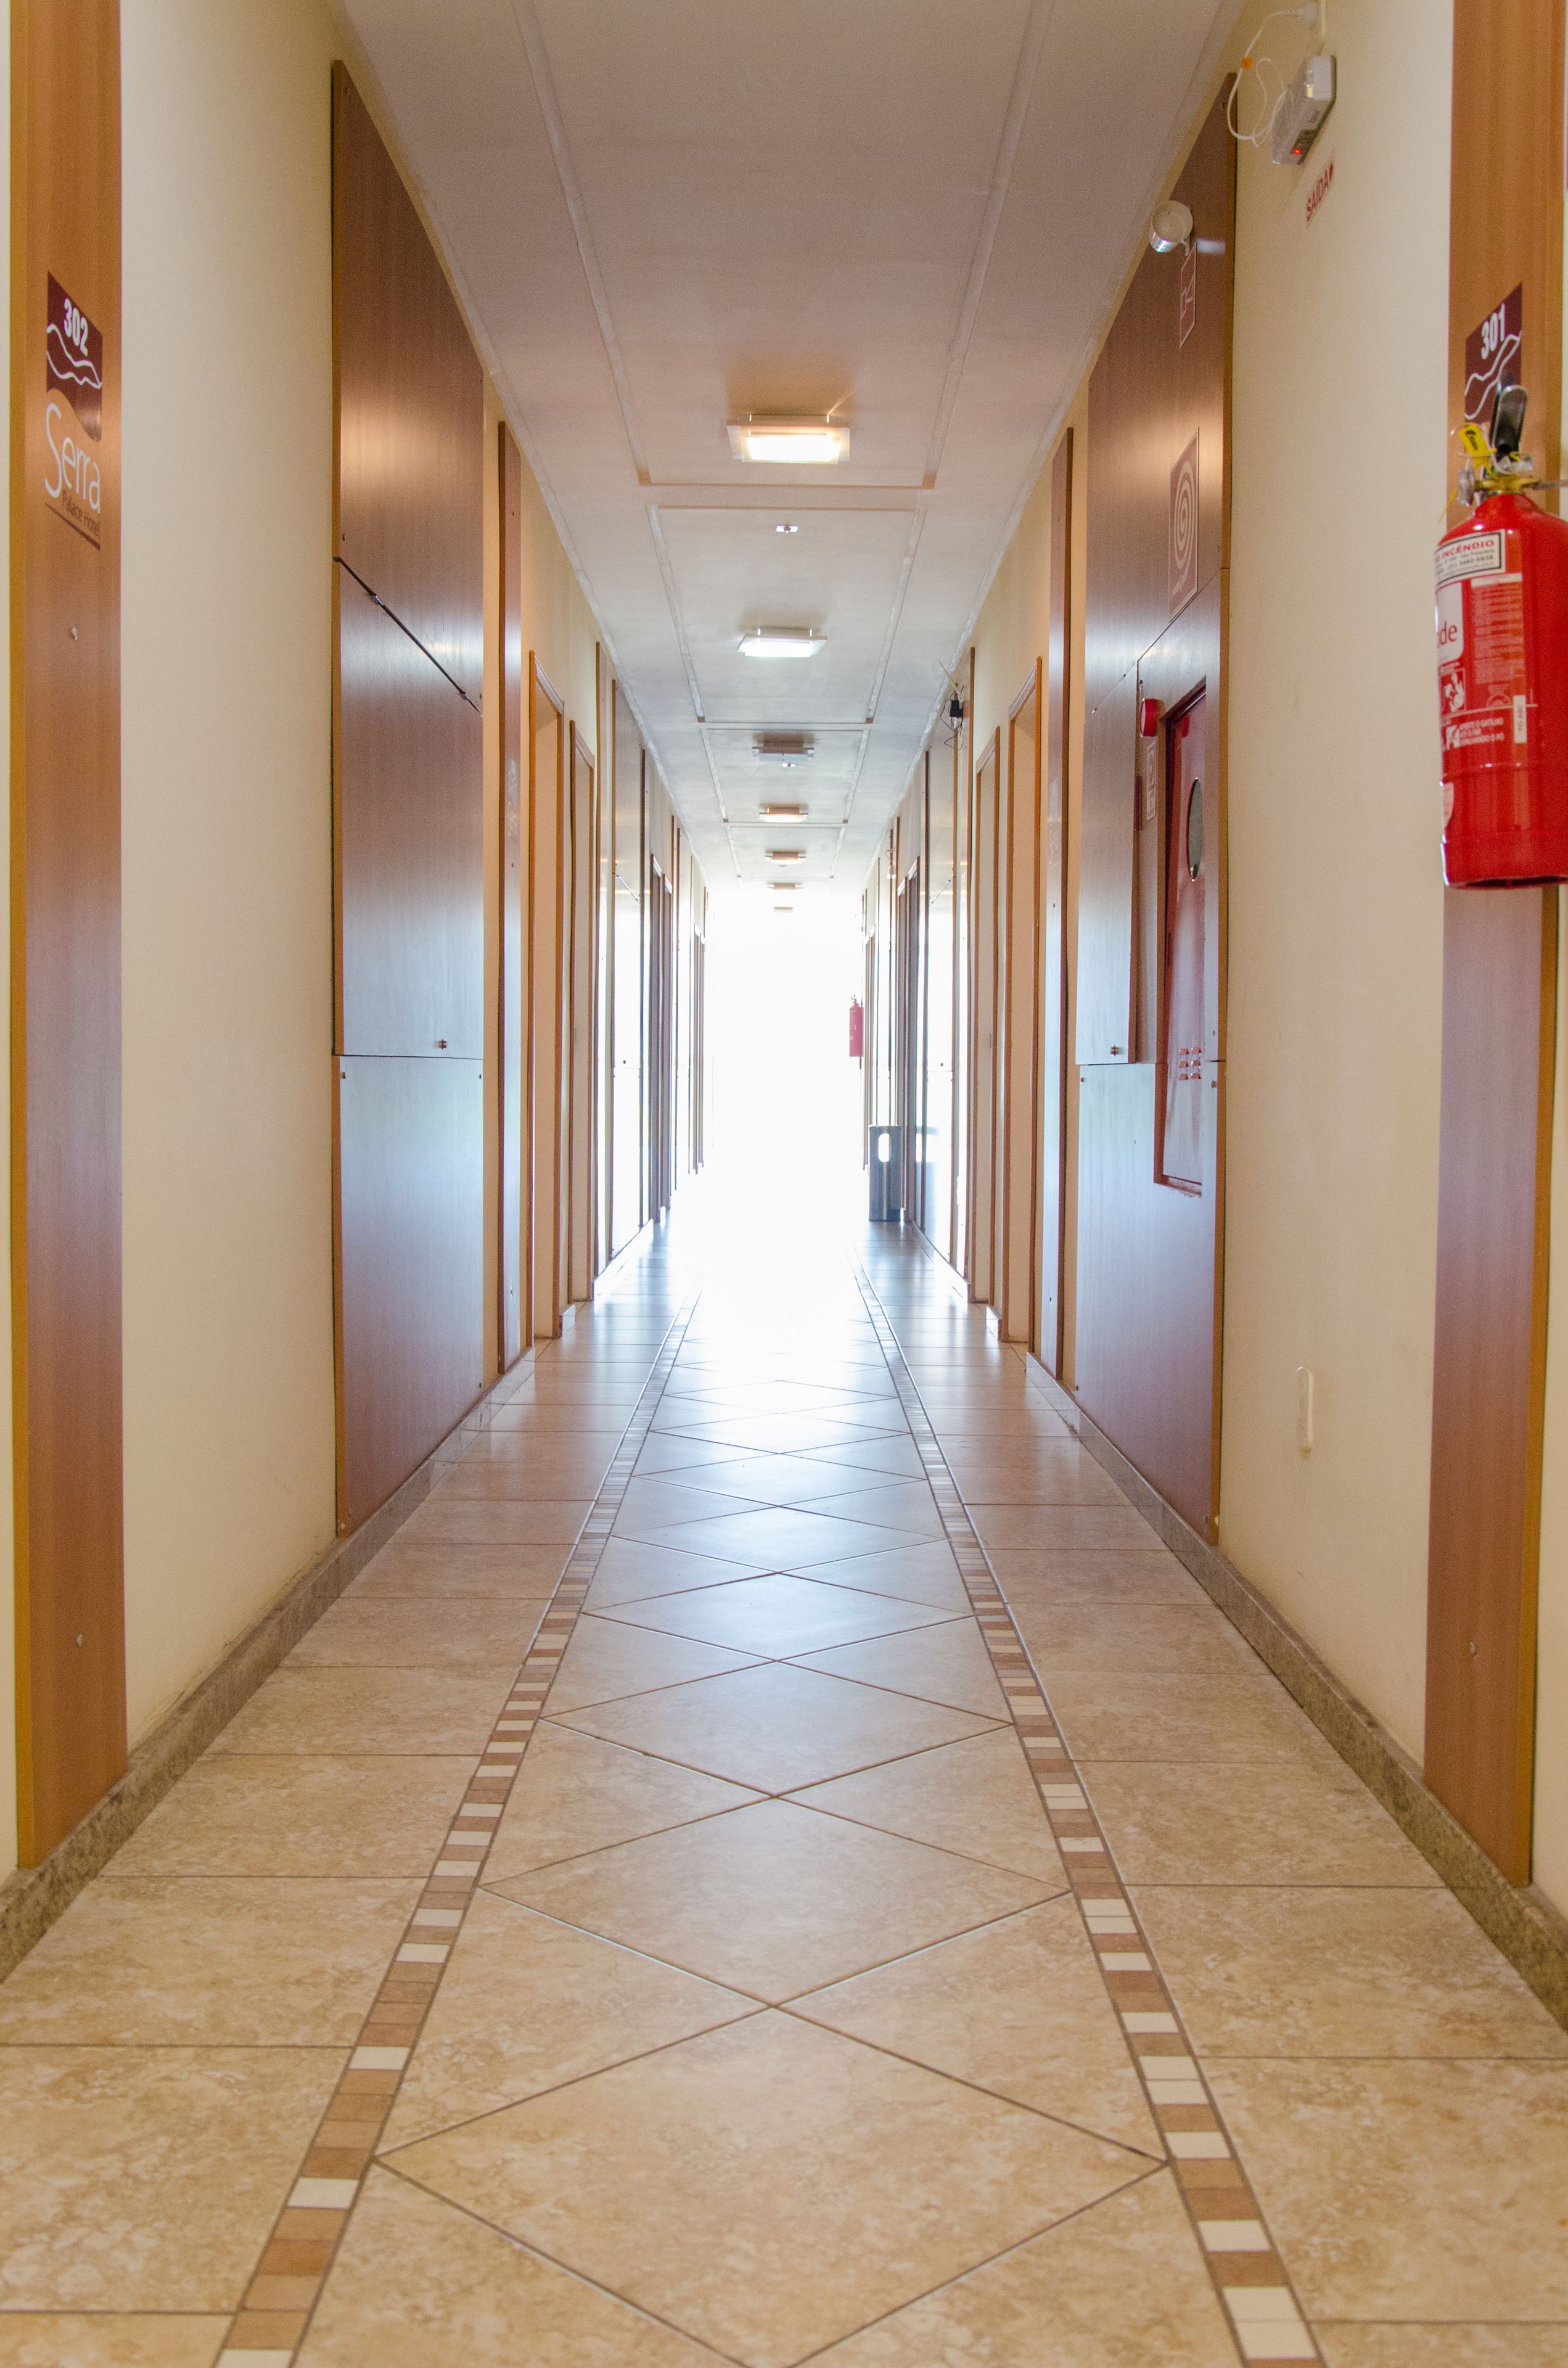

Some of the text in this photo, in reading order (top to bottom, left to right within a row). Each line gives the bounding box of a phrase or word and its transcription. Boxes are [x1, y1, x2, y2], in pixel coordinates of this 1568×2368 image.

[64, 298, 88, 356] 302
[1481, 302, 1505, 360] 301
[44, 403, 101, 513] Serra
[62, 490, 101, 540] Palace Hotel
